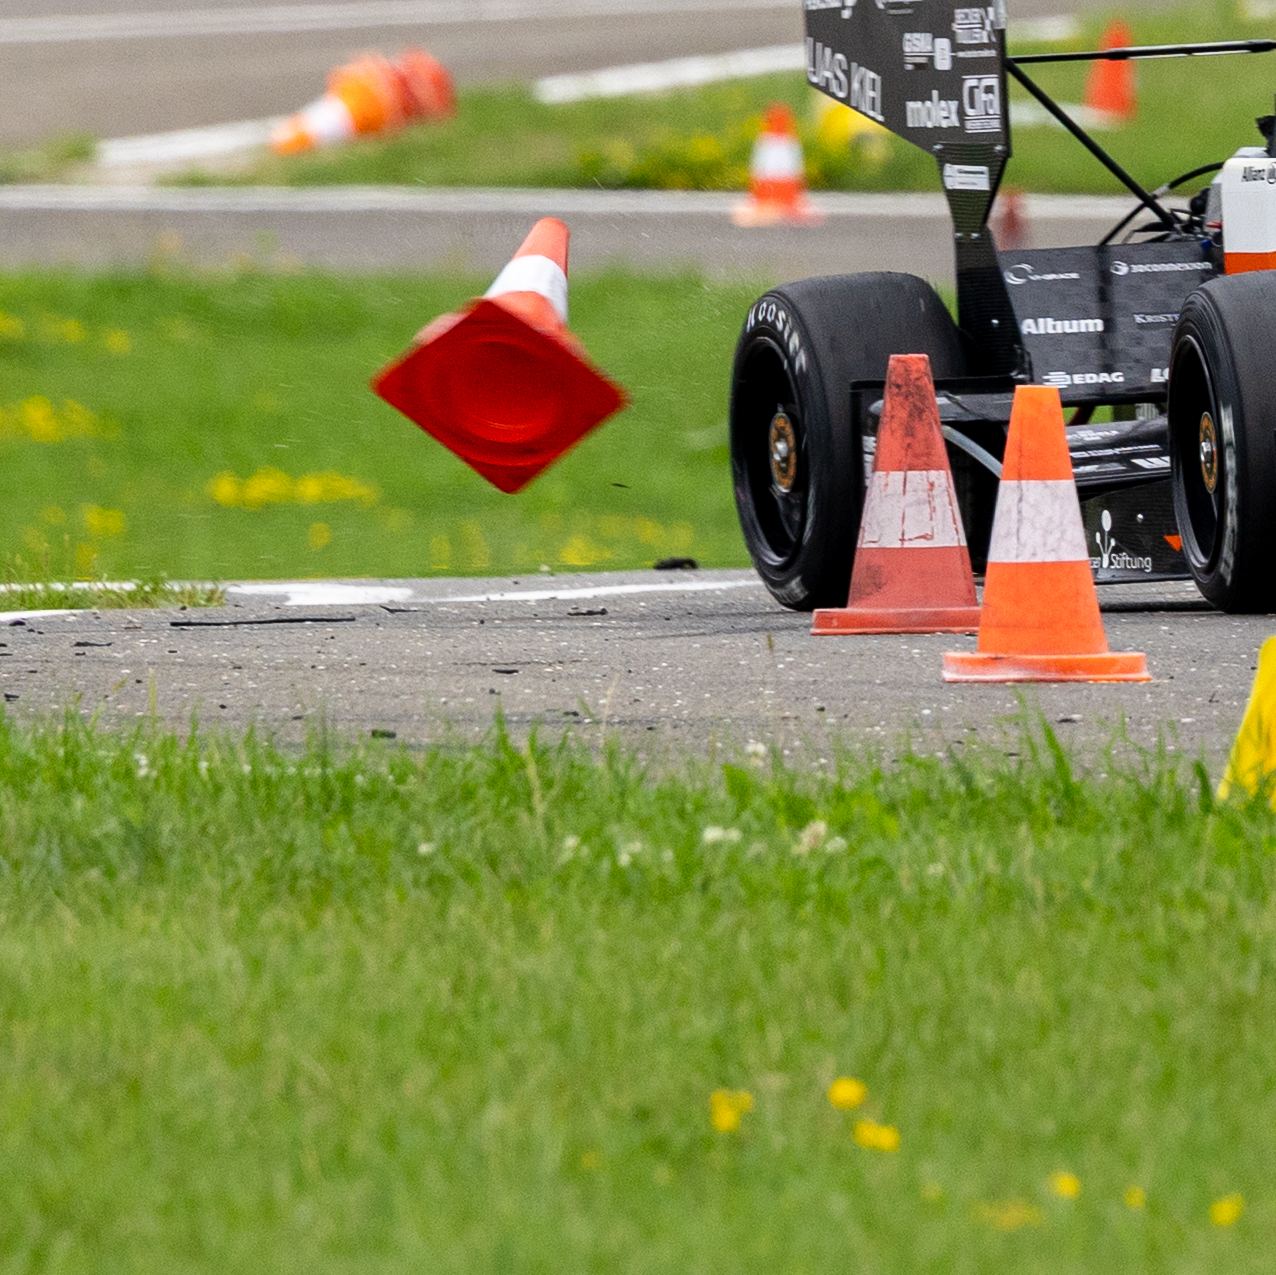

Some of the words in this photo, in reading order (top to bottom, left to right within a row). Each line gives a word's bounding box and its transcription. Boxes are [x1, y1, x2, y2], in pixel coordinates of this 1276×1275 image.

[1021, 317, 1105, 335] Altium
[1072, 372, 1125, 384] EDAG
[1110, 551, 1153, 573] Stiftung
